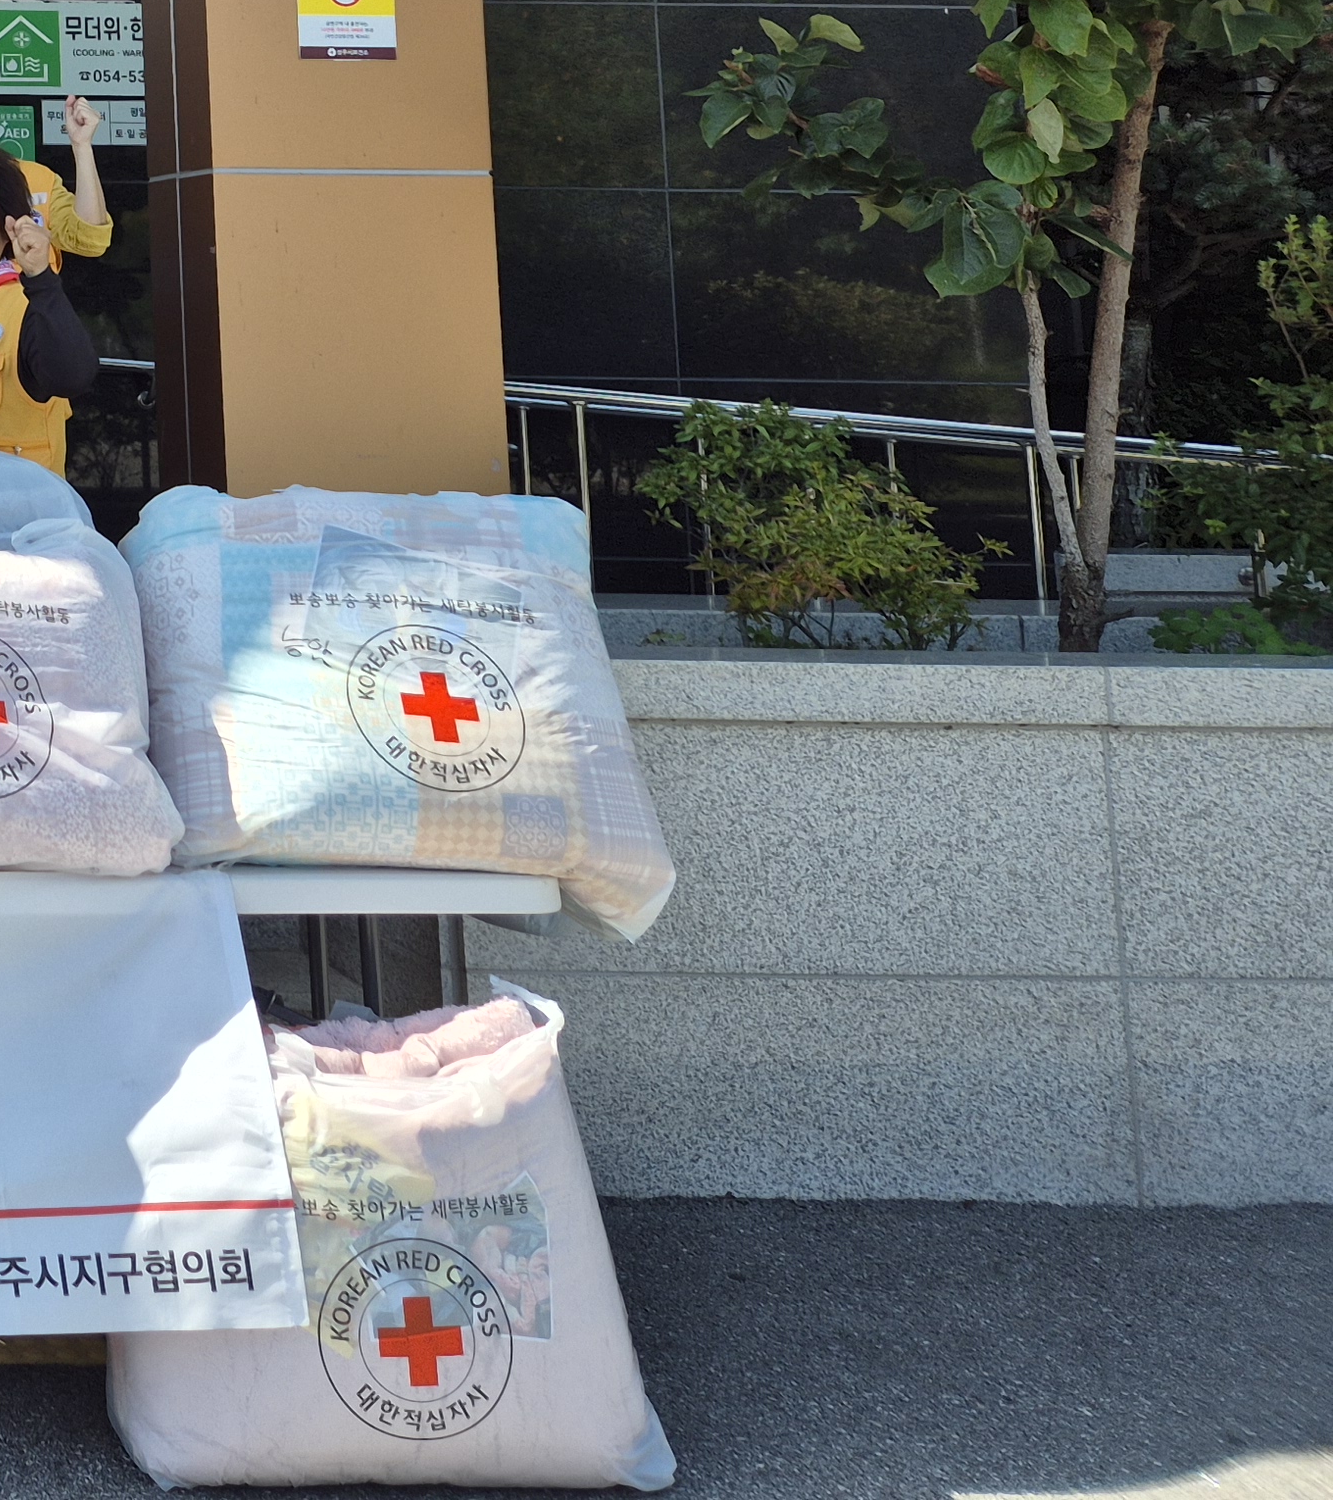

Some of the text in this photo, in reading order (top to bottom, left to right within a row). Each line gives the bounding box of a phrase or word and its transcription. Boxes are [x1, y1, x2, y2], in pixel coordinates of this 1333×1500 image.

[4, 128, 30, 138] AED
[288, 591, 359, 609] 뽀송뽀송
[364, 591, 433, 614] 찾아가는
[357, 633, 513, 712] KOREAN RED CROSS
[384, 734, 508, 785] 대한적십자사
[347, 1198, 425, 1222] 찾아가는
[430, 1192, 530, 1220] 세탁봉사활동
[329, 1249, 500, 1343] KOREAN RED CROSS
[356, 1382, 491, 1432] 대한적십자사
